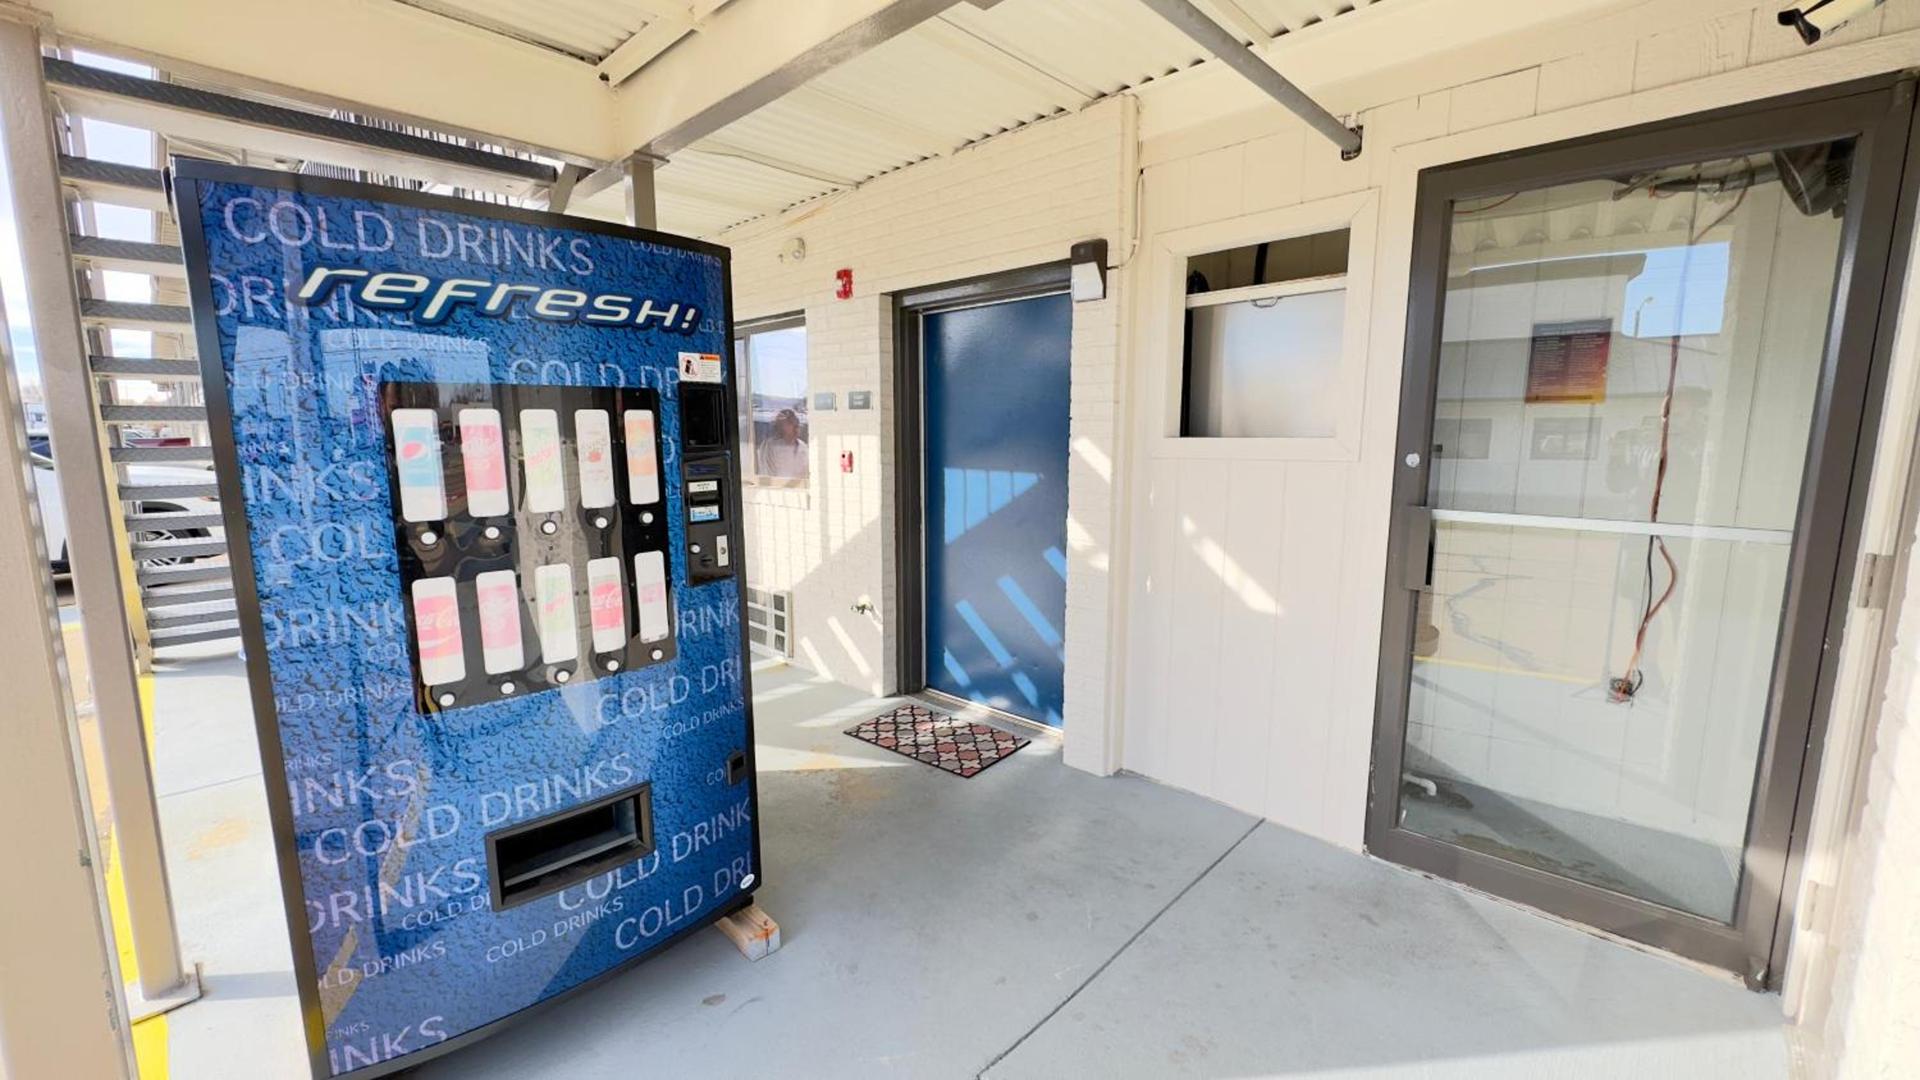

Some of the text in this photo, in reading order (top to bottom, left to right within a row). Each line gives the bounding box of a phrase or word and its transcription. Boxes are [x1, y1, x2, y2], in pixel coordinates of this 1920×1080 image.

[224, 197, 595, 276] COLD DRINKS
[328, 330, 491, 354] COLD DRINKS
[674, 598, 741, 639] RINK
[598, 655, 742, 726] COLD DRI
[663, 697, 745, 741] COLD DRINKS
[315, 752, 633, 865] COLD DRINKS
[559, 797, 750, 911] COLD DRINK
[402, 900, 463, 931] COLD
[486, 895, 624, 963] COLD DRINKS
[614, 850, 751, 950] COLD DRI
[362, 940, 447, 979] DRINKS
